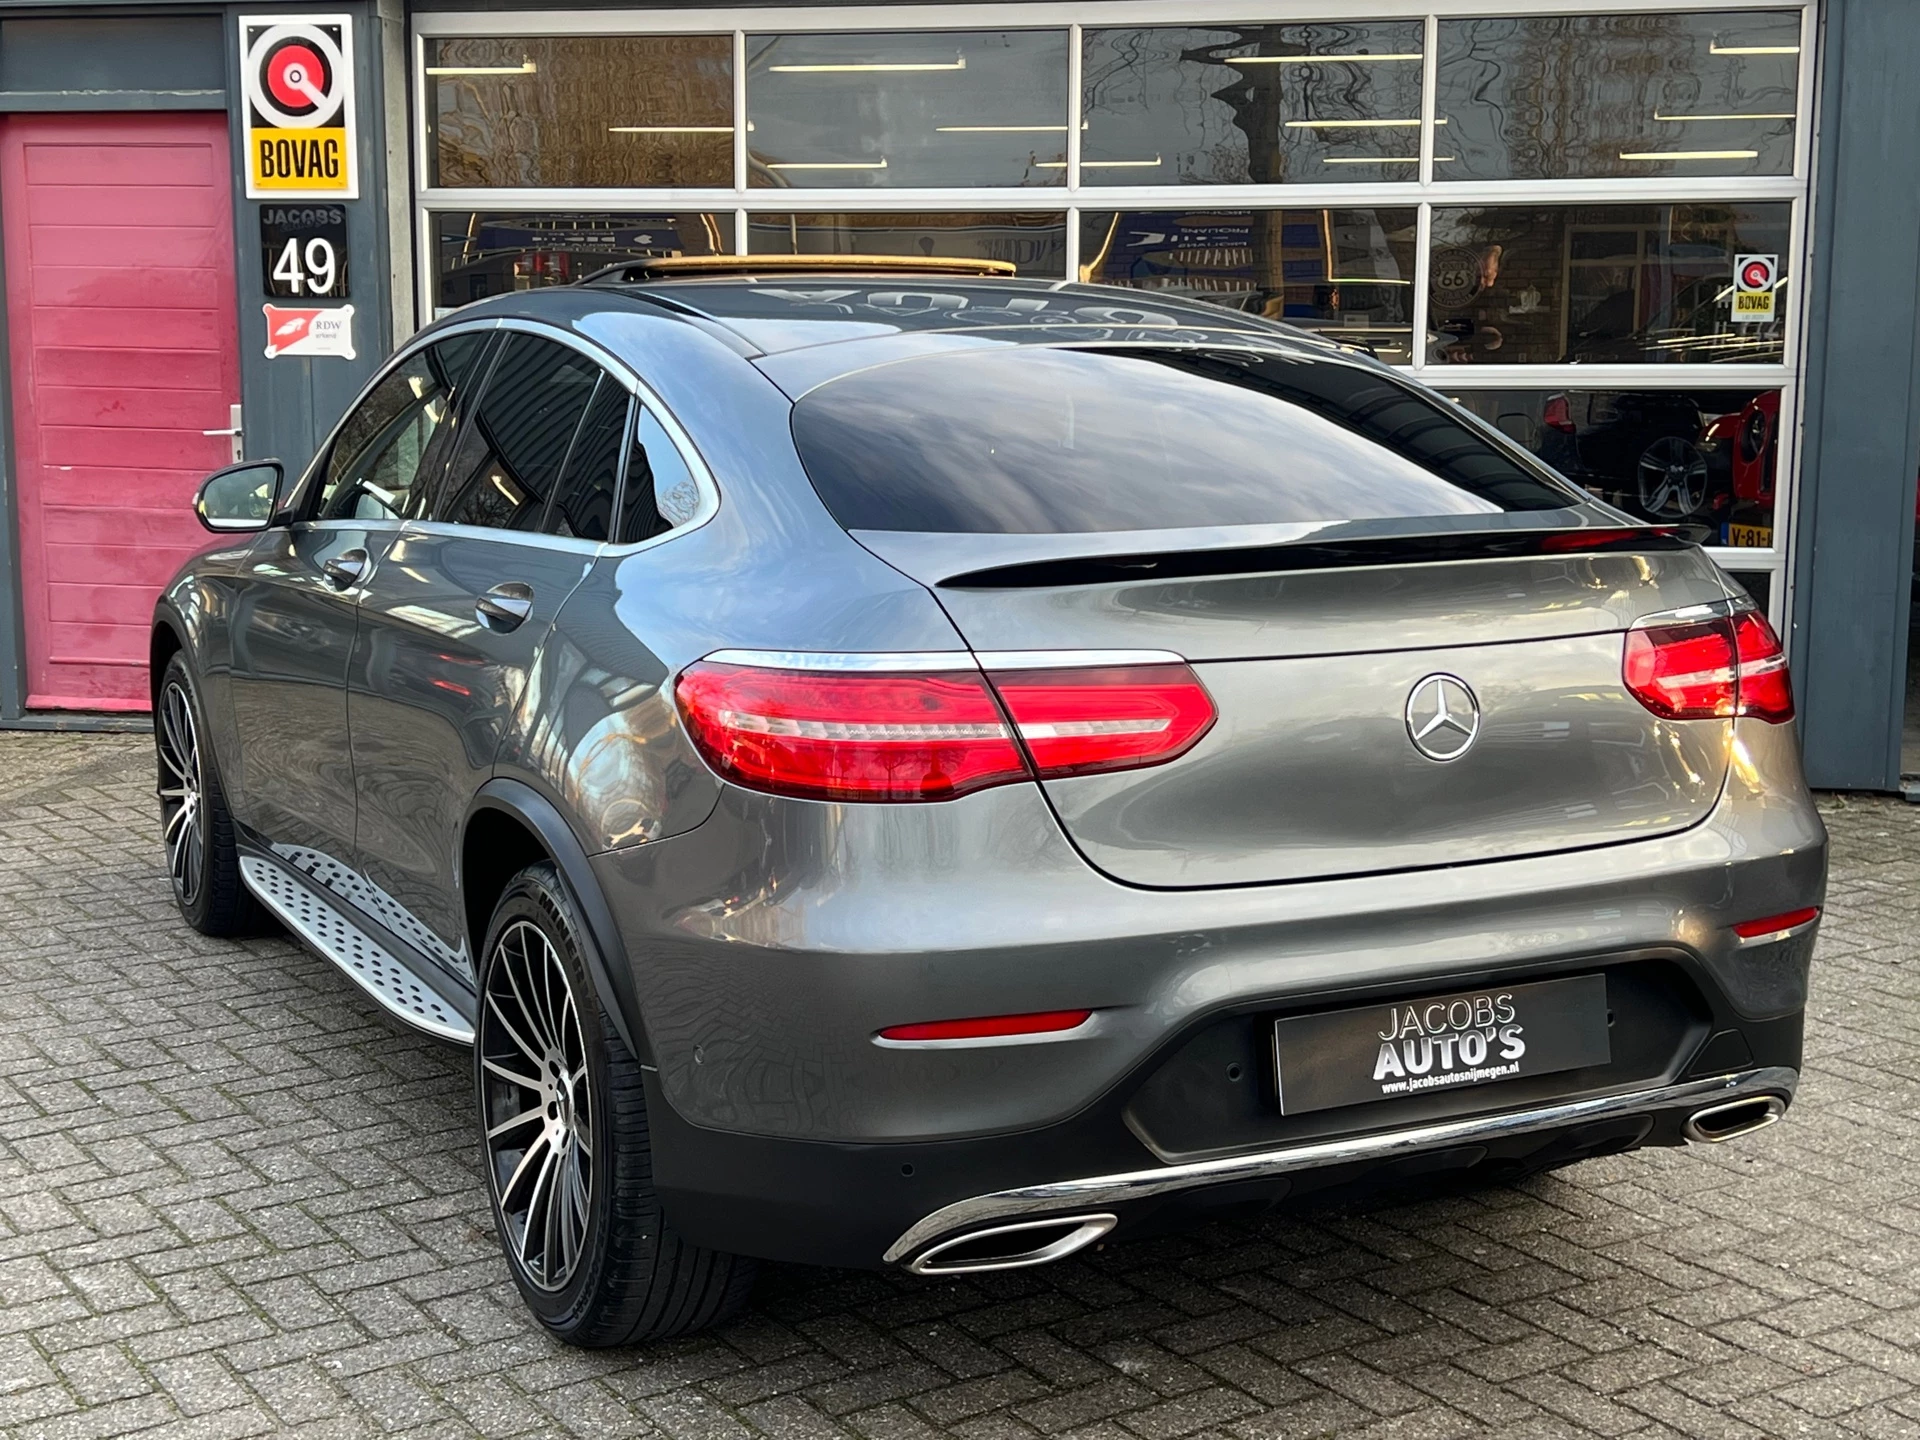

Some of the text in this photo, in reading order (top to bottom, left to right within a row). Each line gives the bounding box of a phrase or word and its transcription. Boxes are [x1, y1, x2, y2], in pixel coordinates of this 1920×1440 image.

[259, 138, 339, 179] BOVAG
[263, 208, 342, 225] JACOBS
[273, 237, 336, 294] 49
[1442, 271, 1465, 287] 66
[1738, 295, 1770, 310] BOVAG
[315, 320, 342, 330] RDW
[539, 891, 592, 1014] MINERV
[1378, 993, 1516, 1041] JACOBS
[1373, 1023, 1526, 1081] AUTO'S
[1381, 1061, 1520, 1093] www.jacobsautosnijmegen.nl
